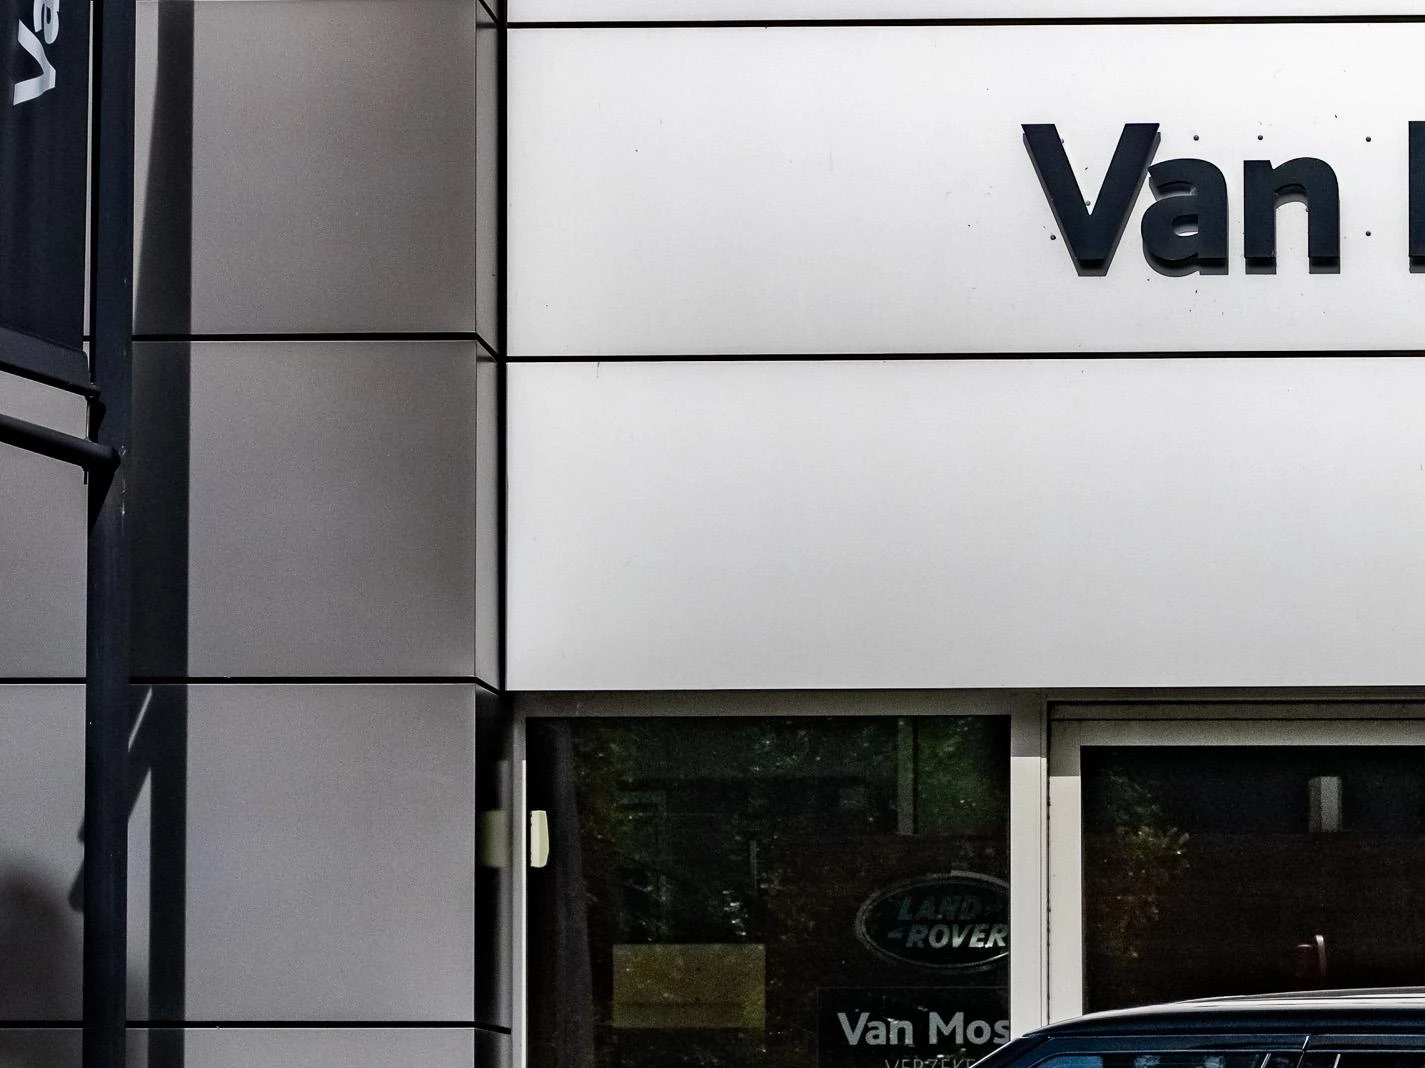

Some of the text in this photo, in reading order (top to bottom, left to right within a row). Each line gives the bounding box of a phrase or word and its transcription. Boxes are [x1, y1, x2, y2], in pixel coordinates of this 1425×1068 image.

[1021, 122, 1340, 268] Van
[897, 896, 982, 920] LAND
[905, 923, 1009, 949] ROVER
[837, 1012, 914, 1045] Van
